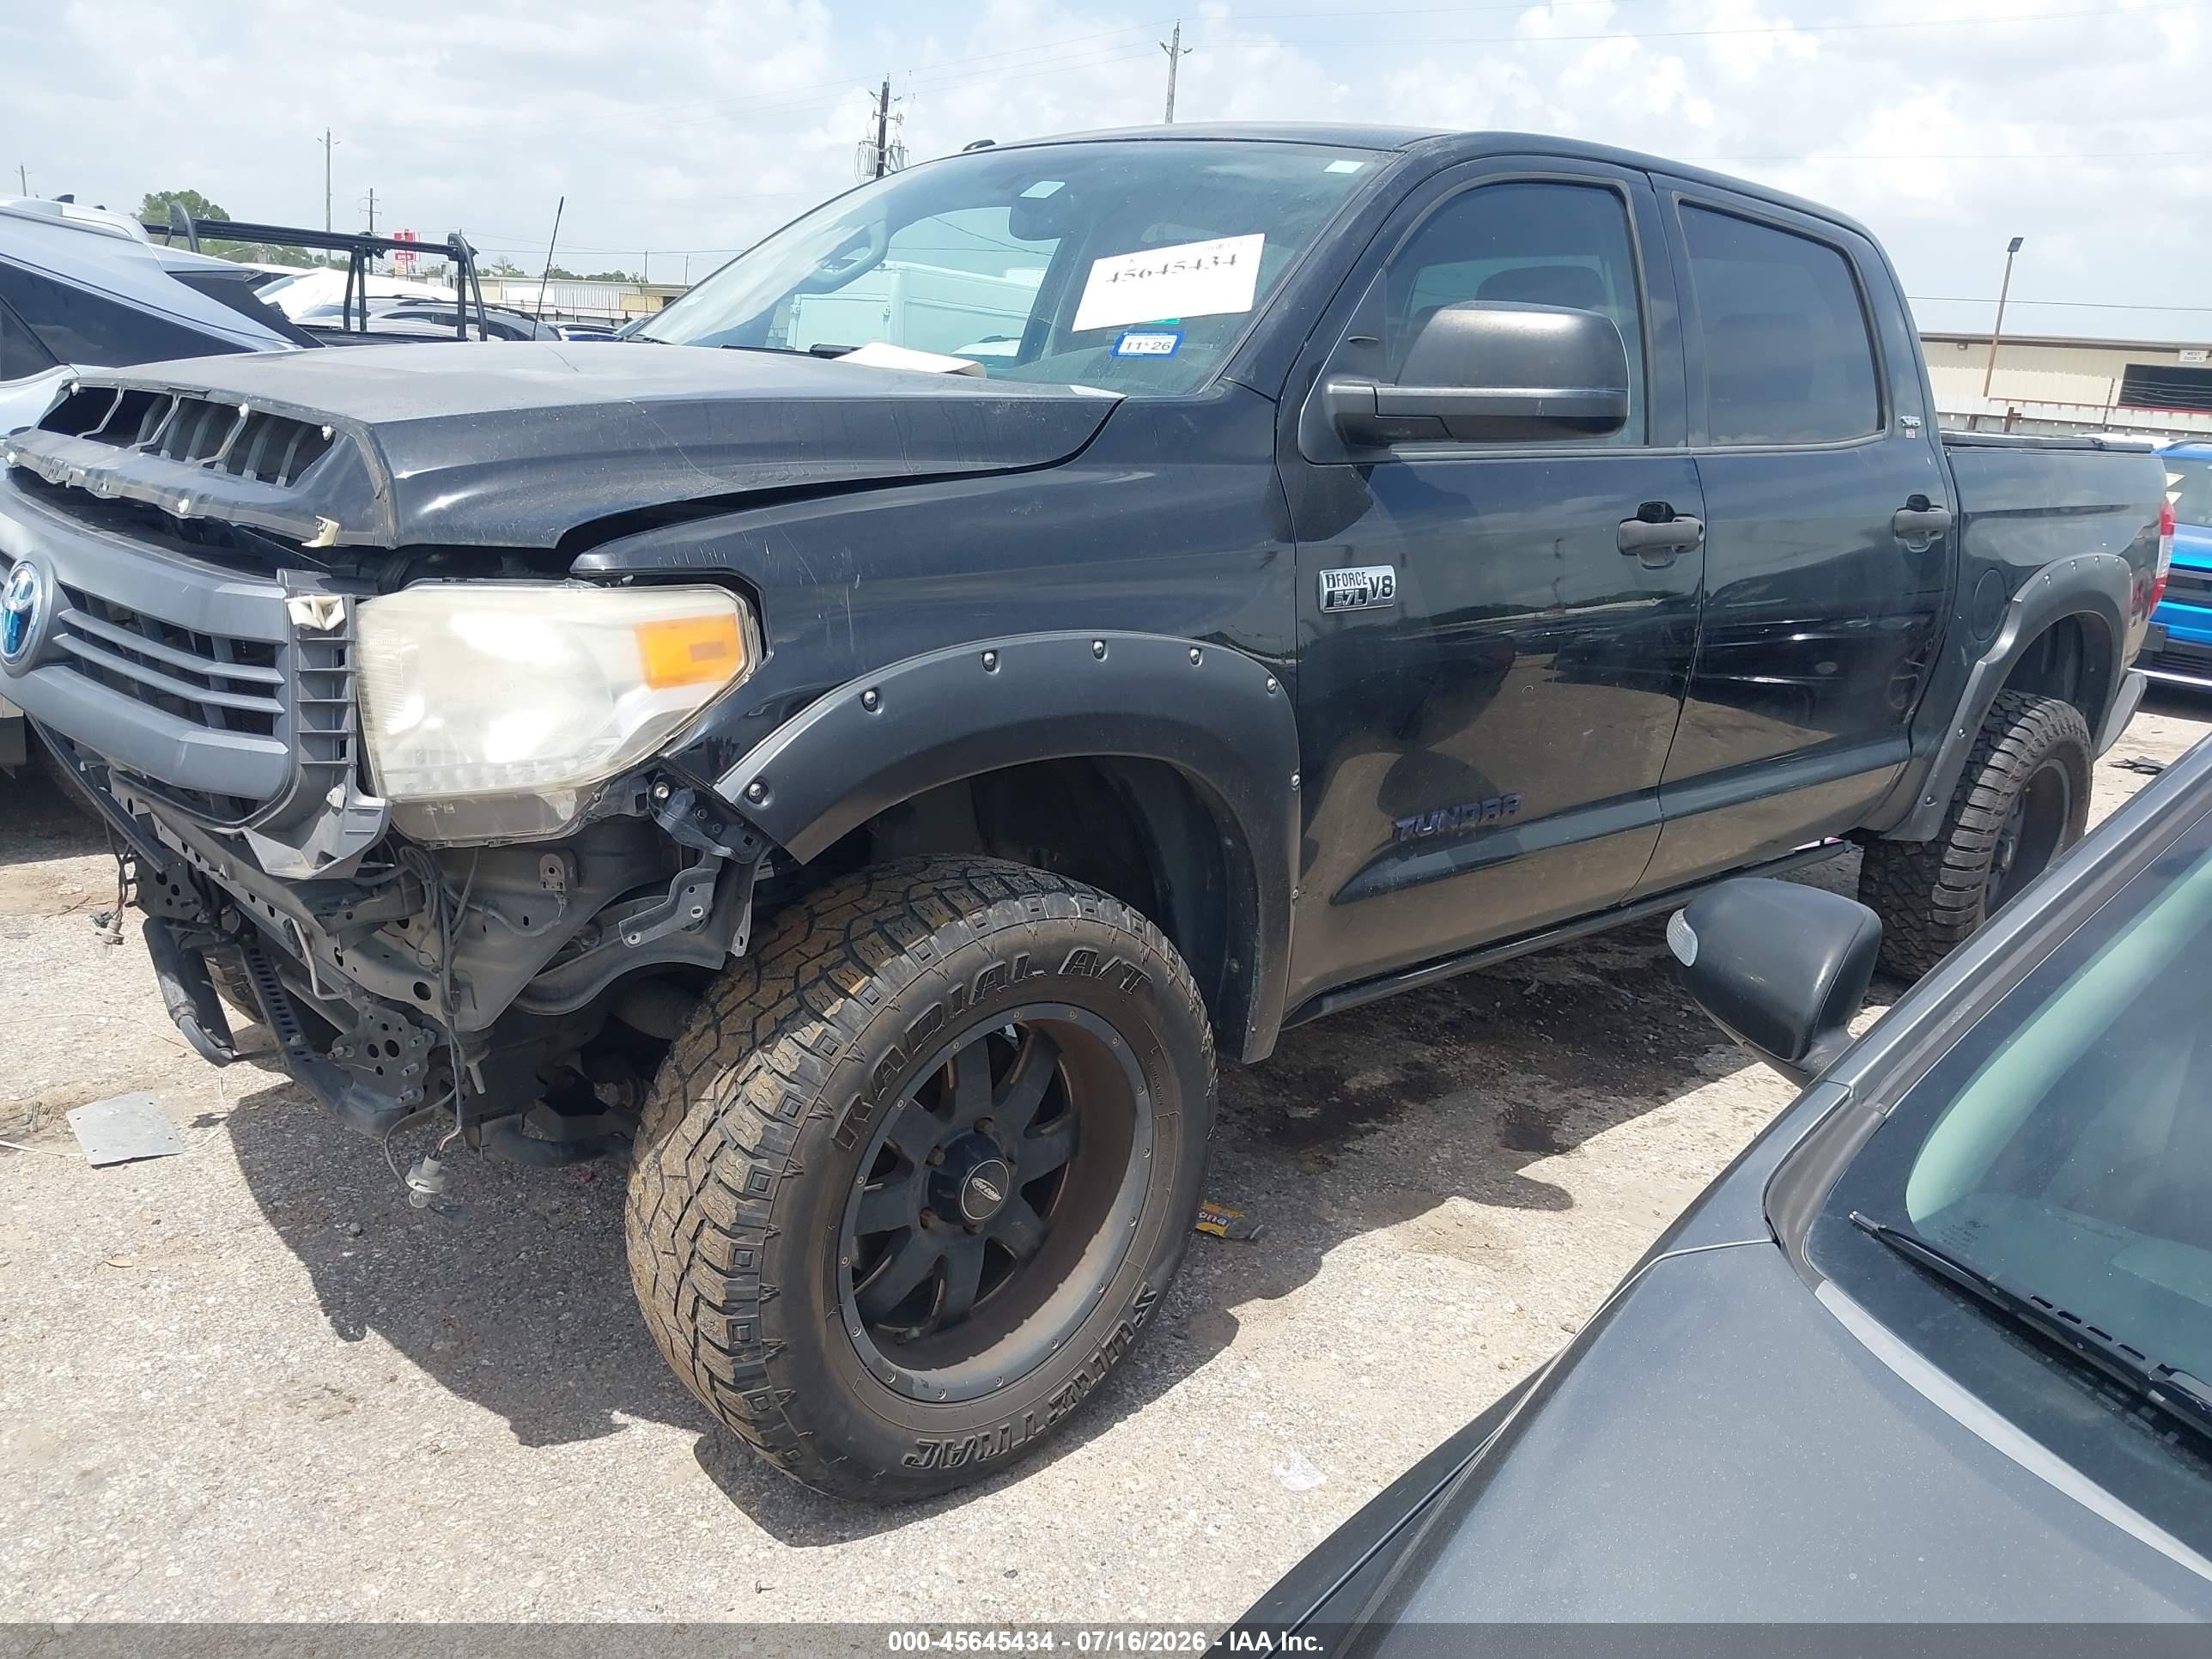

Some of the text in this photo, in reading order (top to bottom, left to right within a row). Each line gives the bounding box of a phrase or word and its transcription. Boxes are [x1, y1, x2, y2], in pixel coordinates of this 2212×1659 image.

[1150, 341, 1172, 350] 26
[1368, 575, 1394, 599] V8
[1392, 792, 1521, 842] TUNDRA
[830, 951, 1049, 1152] RADIAL
